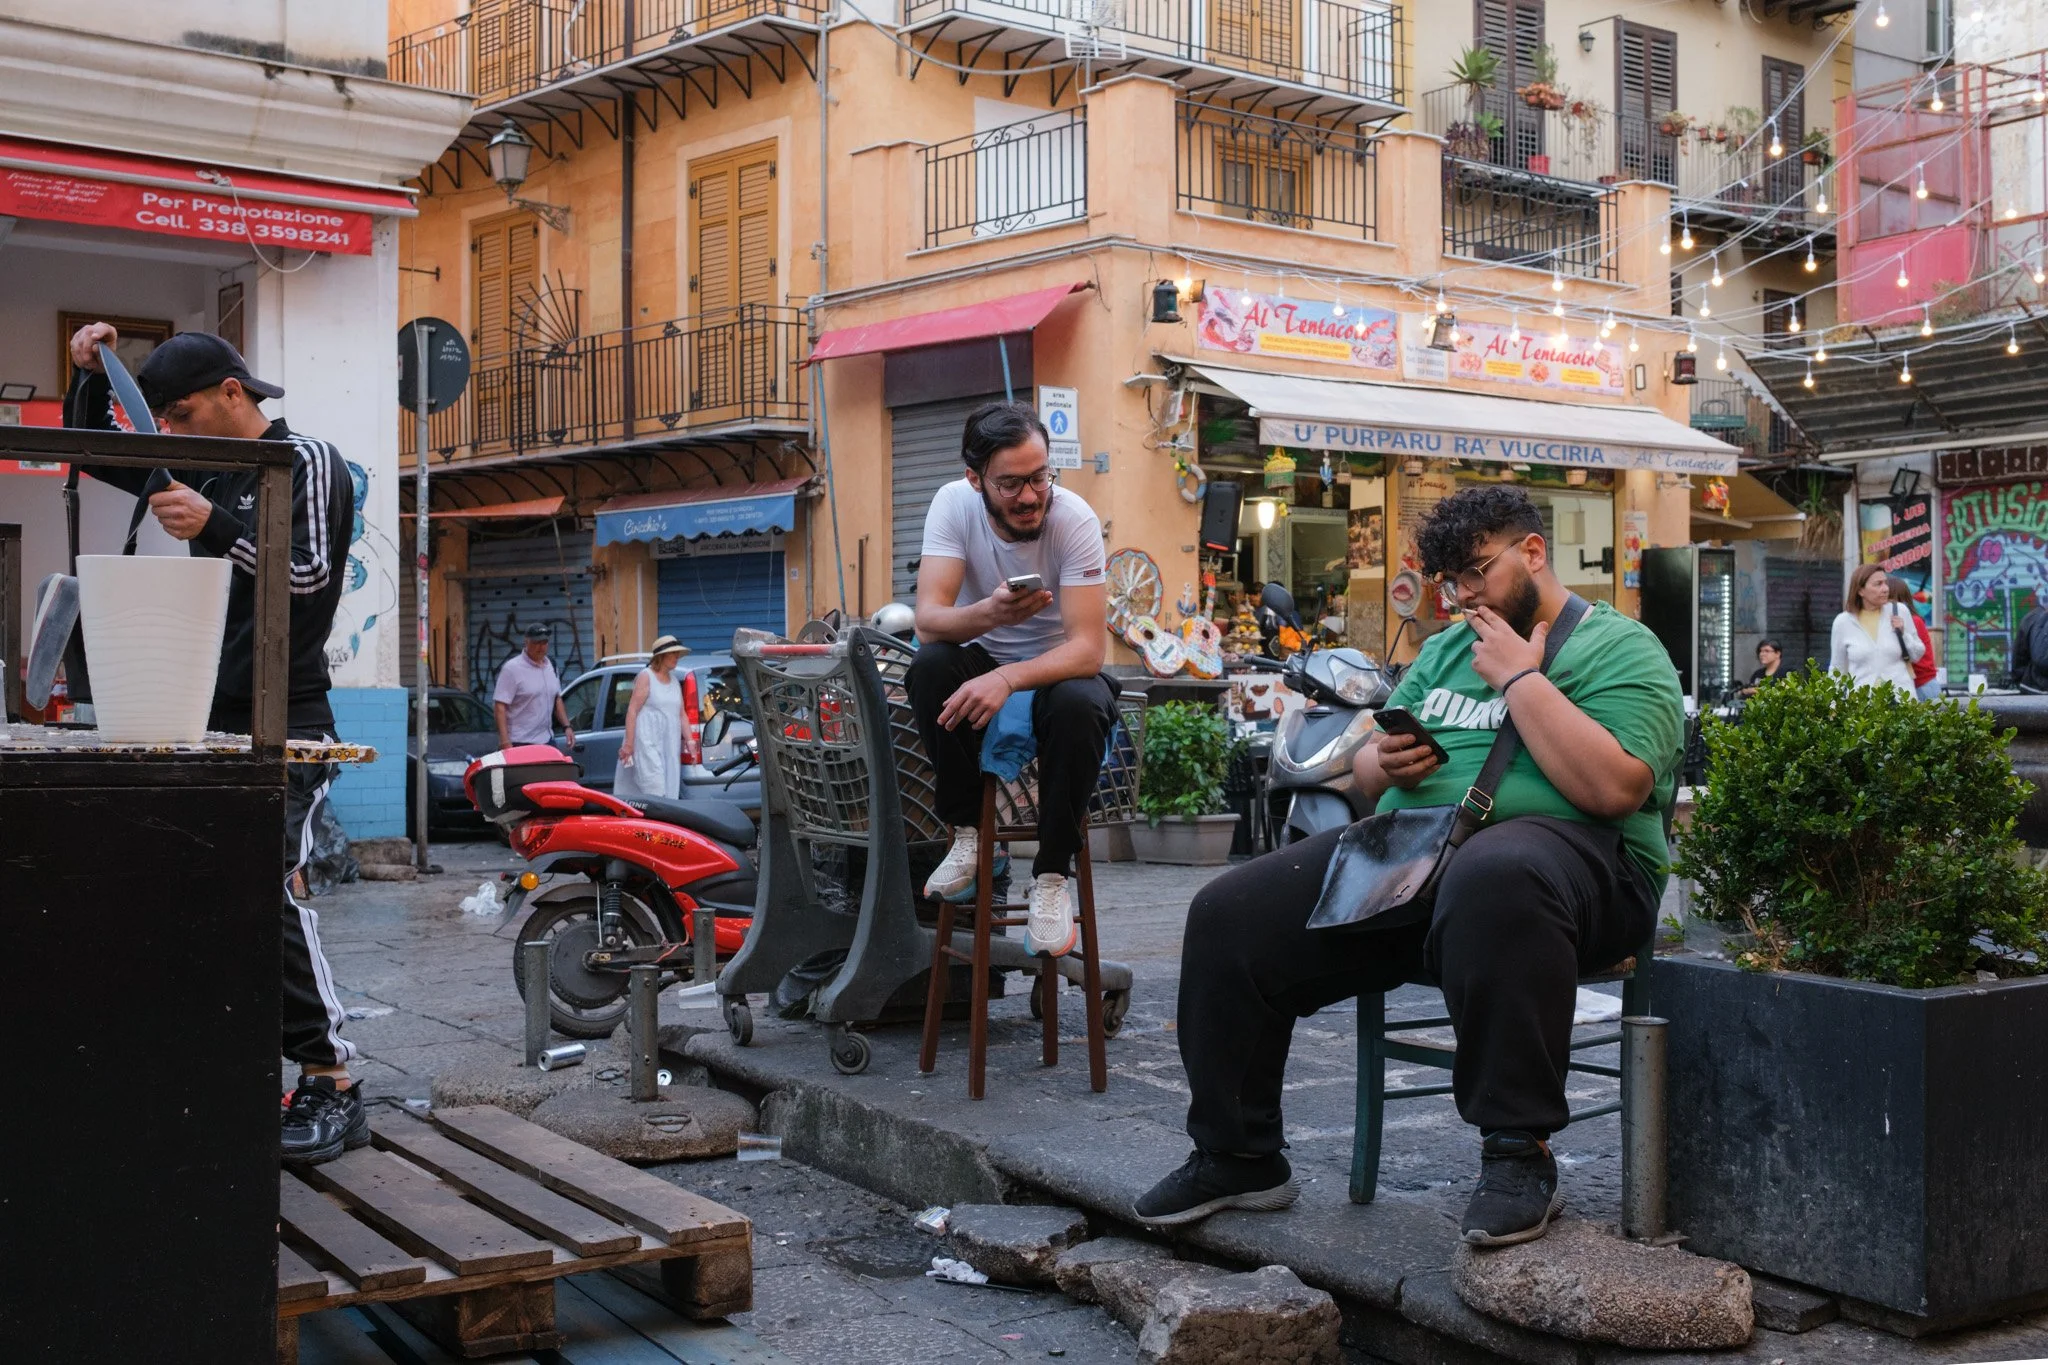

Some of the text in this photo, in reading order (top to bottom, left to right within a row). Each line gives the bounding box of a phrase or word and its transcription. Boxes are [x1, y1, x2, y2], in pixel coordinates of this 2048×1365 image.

[142, 192, 344, 226] Per Prenotazione
[136, 210, 350, 245] Cell. 338 3598241
[1241, 302, 1268, 332] Al
[1484, 335, 1508, 358] Al
[1512, 336, 1596, 368] Tentacolo
[1325, 426, 1442, 451] PURPARU
[1500, 440, 1605, 464] VUCCIRIA
[1633, 450, 1653, 466] Al
